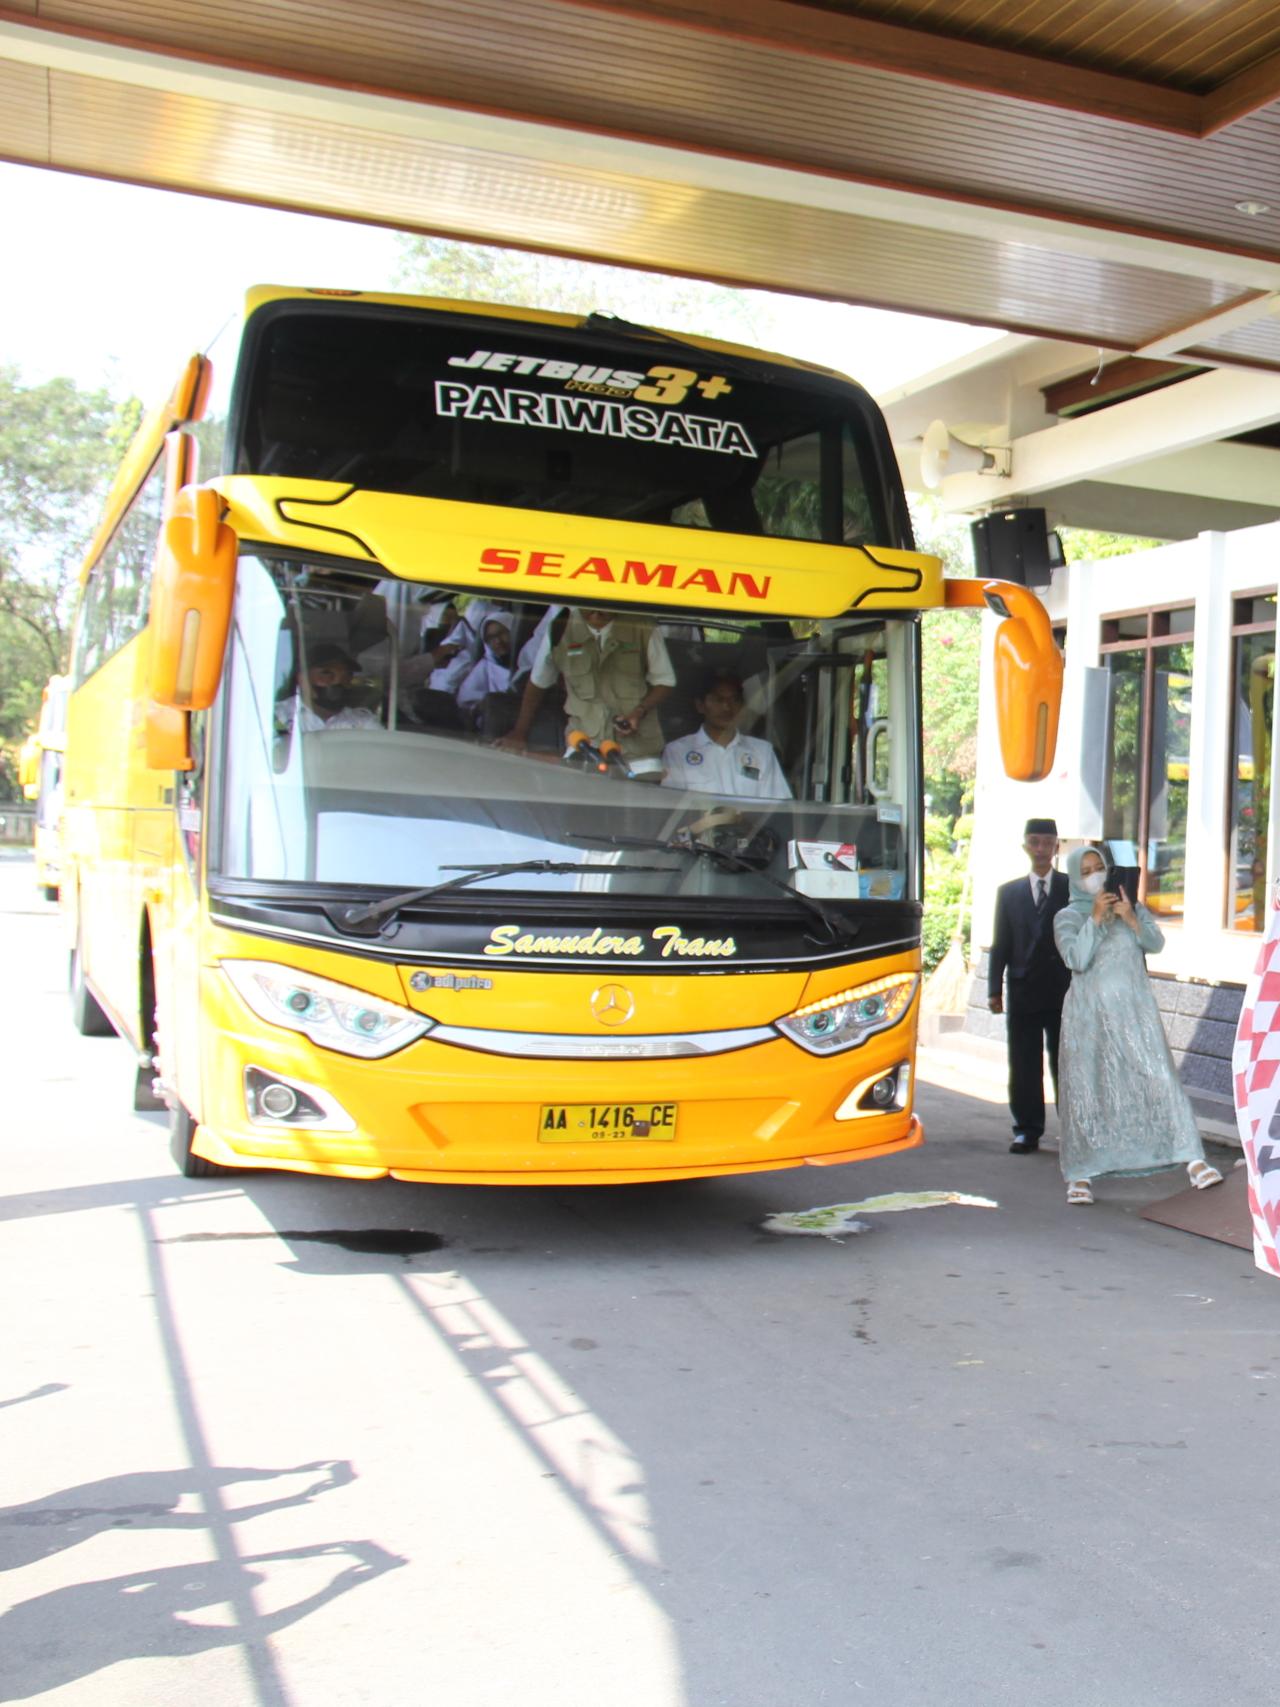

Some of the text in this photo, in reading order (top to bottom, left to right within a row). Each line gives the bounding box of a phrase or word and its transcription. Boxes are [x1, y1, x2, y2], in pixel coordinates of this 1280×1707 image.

[447, 350, 646, 390] JETBUS
[434, 381, 758, 458] PARIWISATA
[478, 547, 772, 600] SEAMAN
[483, 925, 737, 957] Samudera Trans
[543, 1105, 675, 1130] AA 1416 CE
